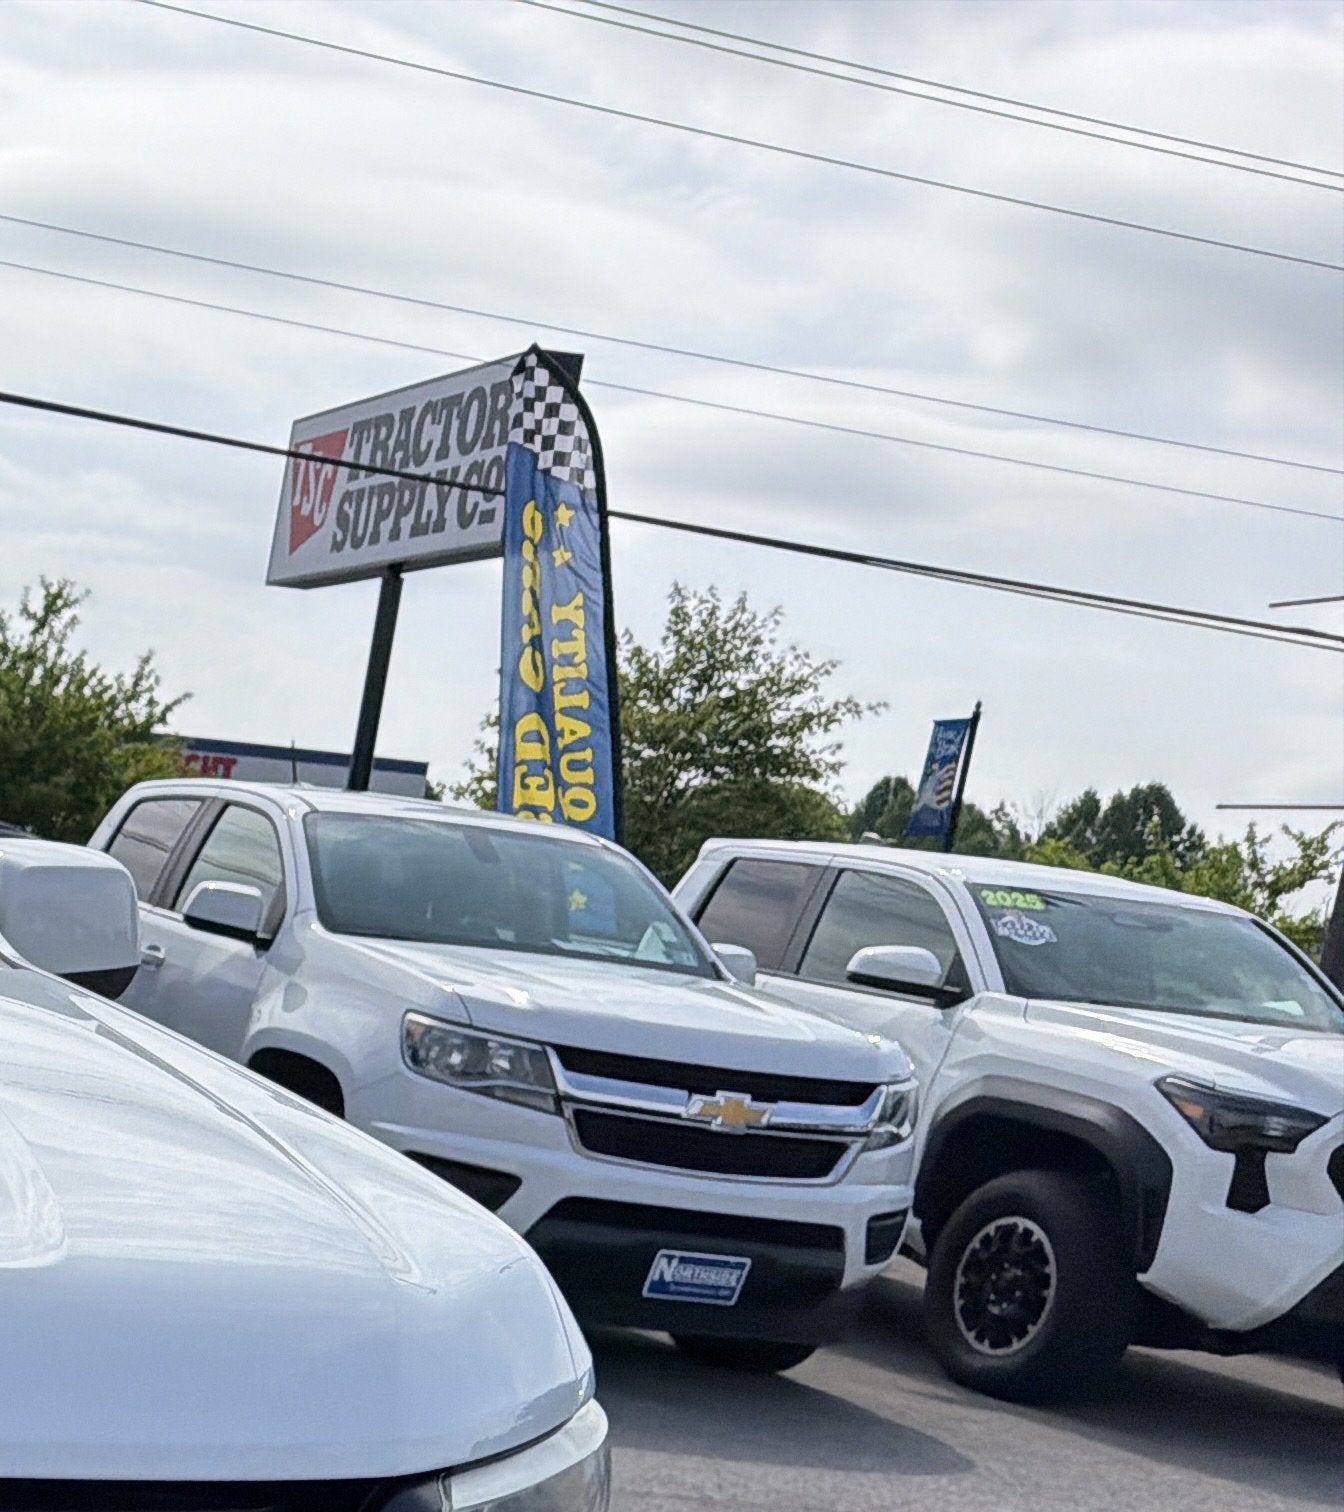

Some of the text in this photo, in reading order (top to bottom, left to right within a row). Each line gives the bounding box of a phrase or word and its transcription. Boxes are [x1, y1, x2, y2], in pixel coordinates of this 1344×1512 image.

[345, 380, 514, 484] TRACTOR
[292, 443, 333, 526] TSC
[330, 462, 462, 554] SUPPLY
[981, 889, 1046, 911] 2025
